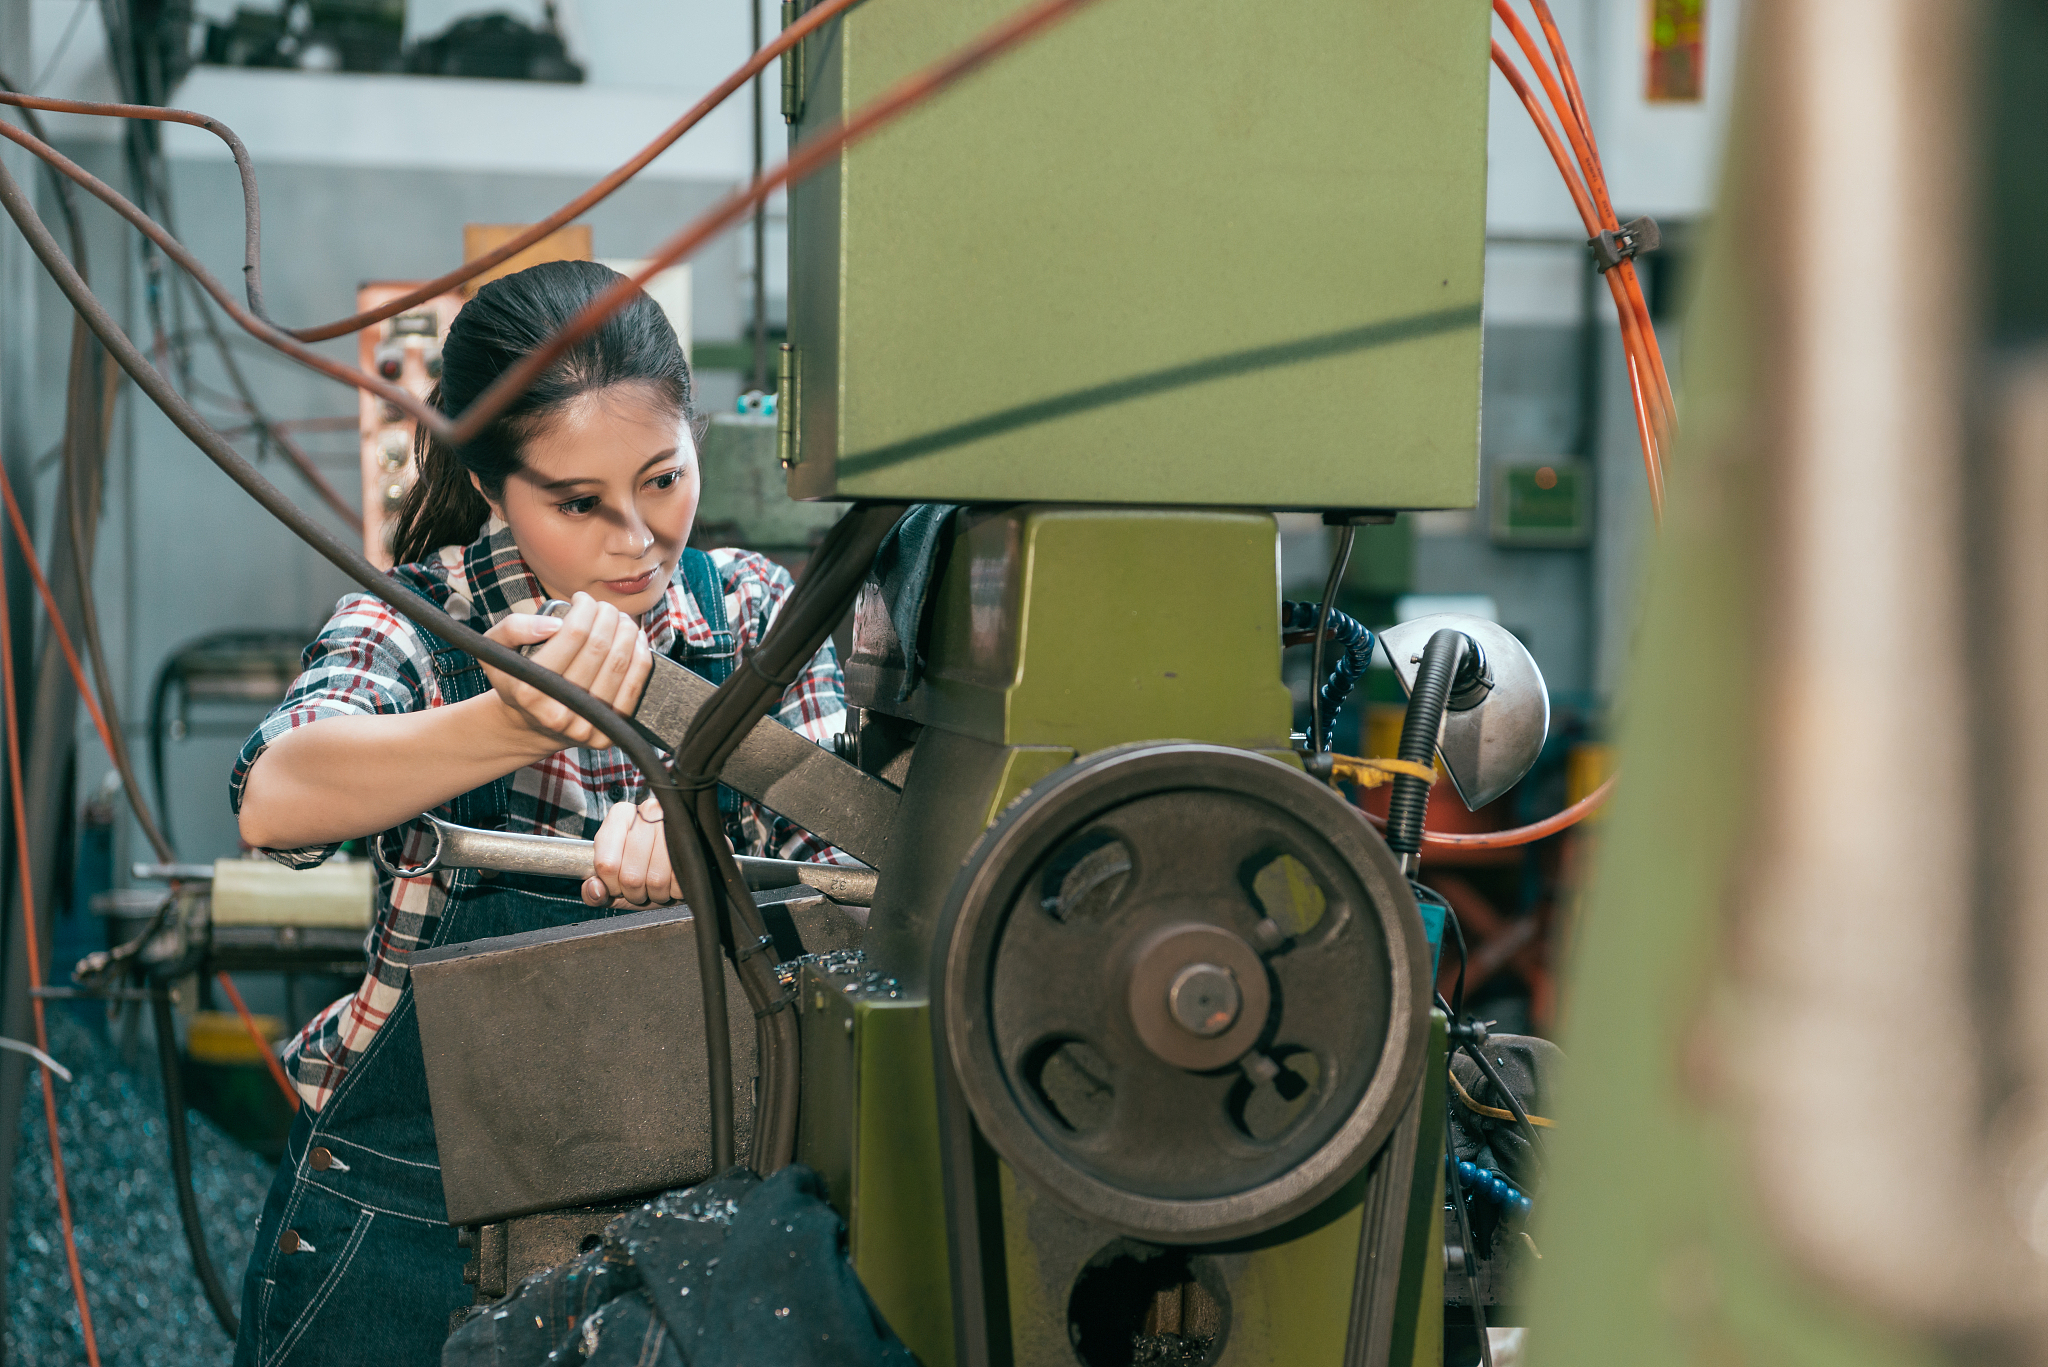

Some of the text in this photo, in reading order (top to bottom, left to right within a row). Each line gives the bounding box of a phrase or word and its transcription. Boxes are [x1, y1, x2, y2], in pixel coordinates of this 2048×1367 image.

[1586, 157, 1597, 182] TAIWAN
[1602, 201, 1612, 218] MADE
[830, 879, 847, 891] 32
